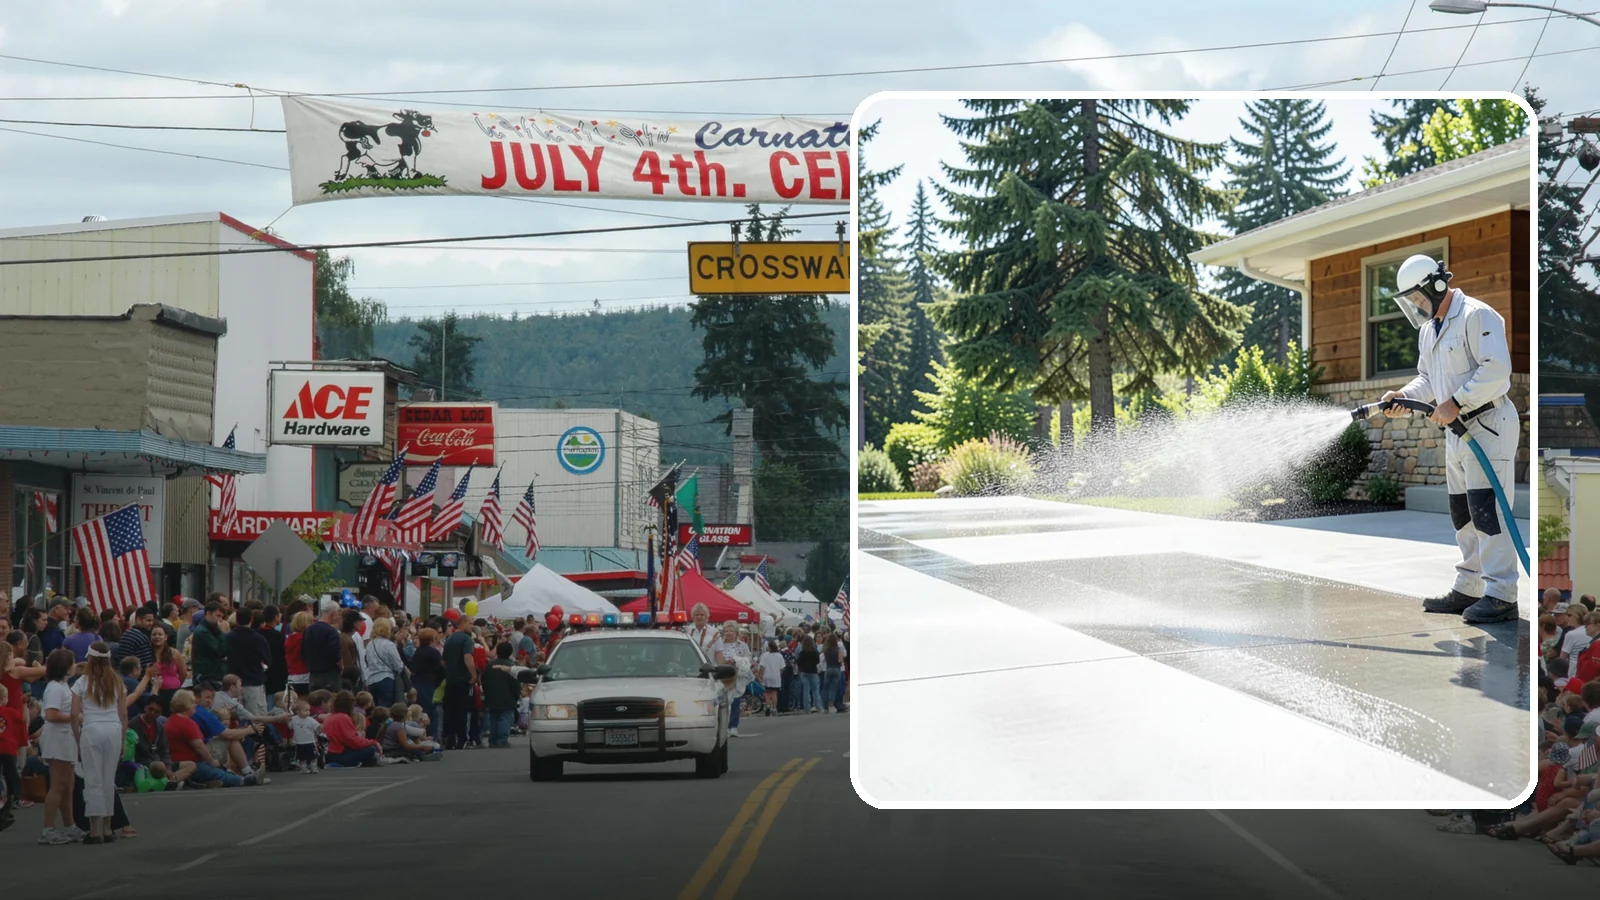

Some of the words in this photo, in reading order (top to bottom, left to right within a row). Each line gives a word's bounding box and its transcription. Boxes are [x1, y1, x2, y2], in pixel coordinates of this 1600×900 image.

[481, 141, 604, 192] JULY
[632, 150, 746, 198] 4th.
[697, 254, 850, 280] CROSSWA
[282, 380, 374, 420] ACE
[405, 409, 453, 422] CEDAR
[283, 421, 371, 437] Hardware
[416, 428, 478, 447] Coca-Cola
[83, 484, 94, 494] St.
[96, 485, 124, 495] Vincent
[126, 486, 136, 495] de
[137, 486, 155, 496] Paul
[688, 526, 741, 536] CRNATION
[699, 535, 730, 543] GLASS
